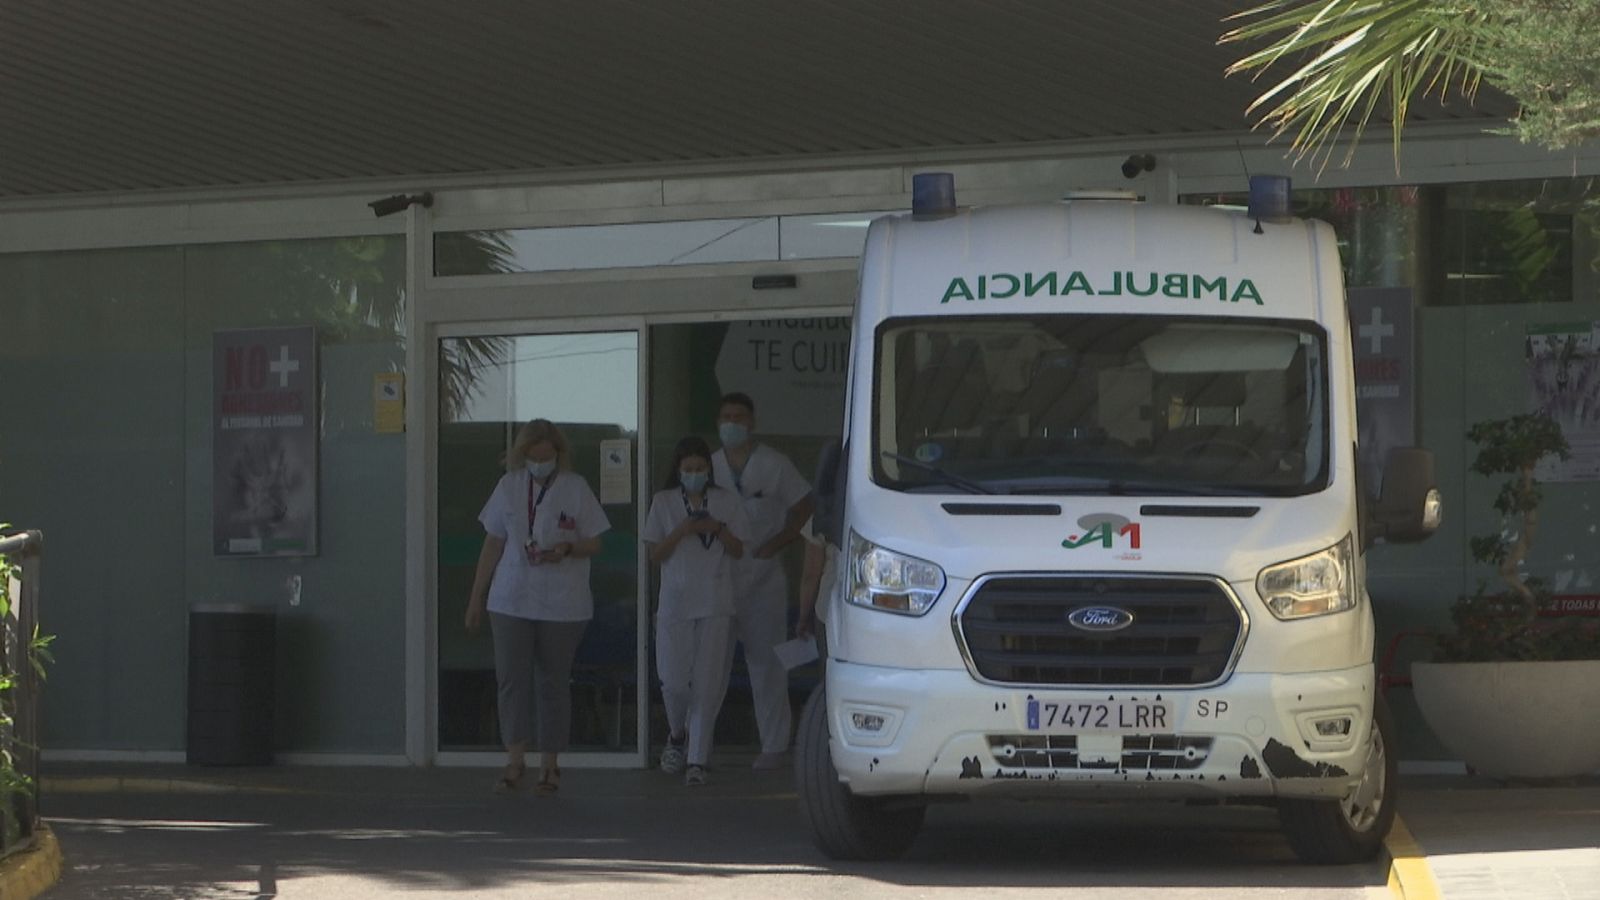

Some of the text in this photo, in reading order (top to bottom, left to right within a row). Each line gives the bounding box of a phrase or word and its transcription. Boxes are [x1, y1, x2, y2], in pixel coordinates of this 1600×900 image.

[225, 344, 266, 390] NO
[748, 339, 782, 371] TE
[1083, 609, 1118, 625] Ford
[1561, 599, 1595, 611] TODAS
[1045, 704, 1166, 728] 7472 LRR
